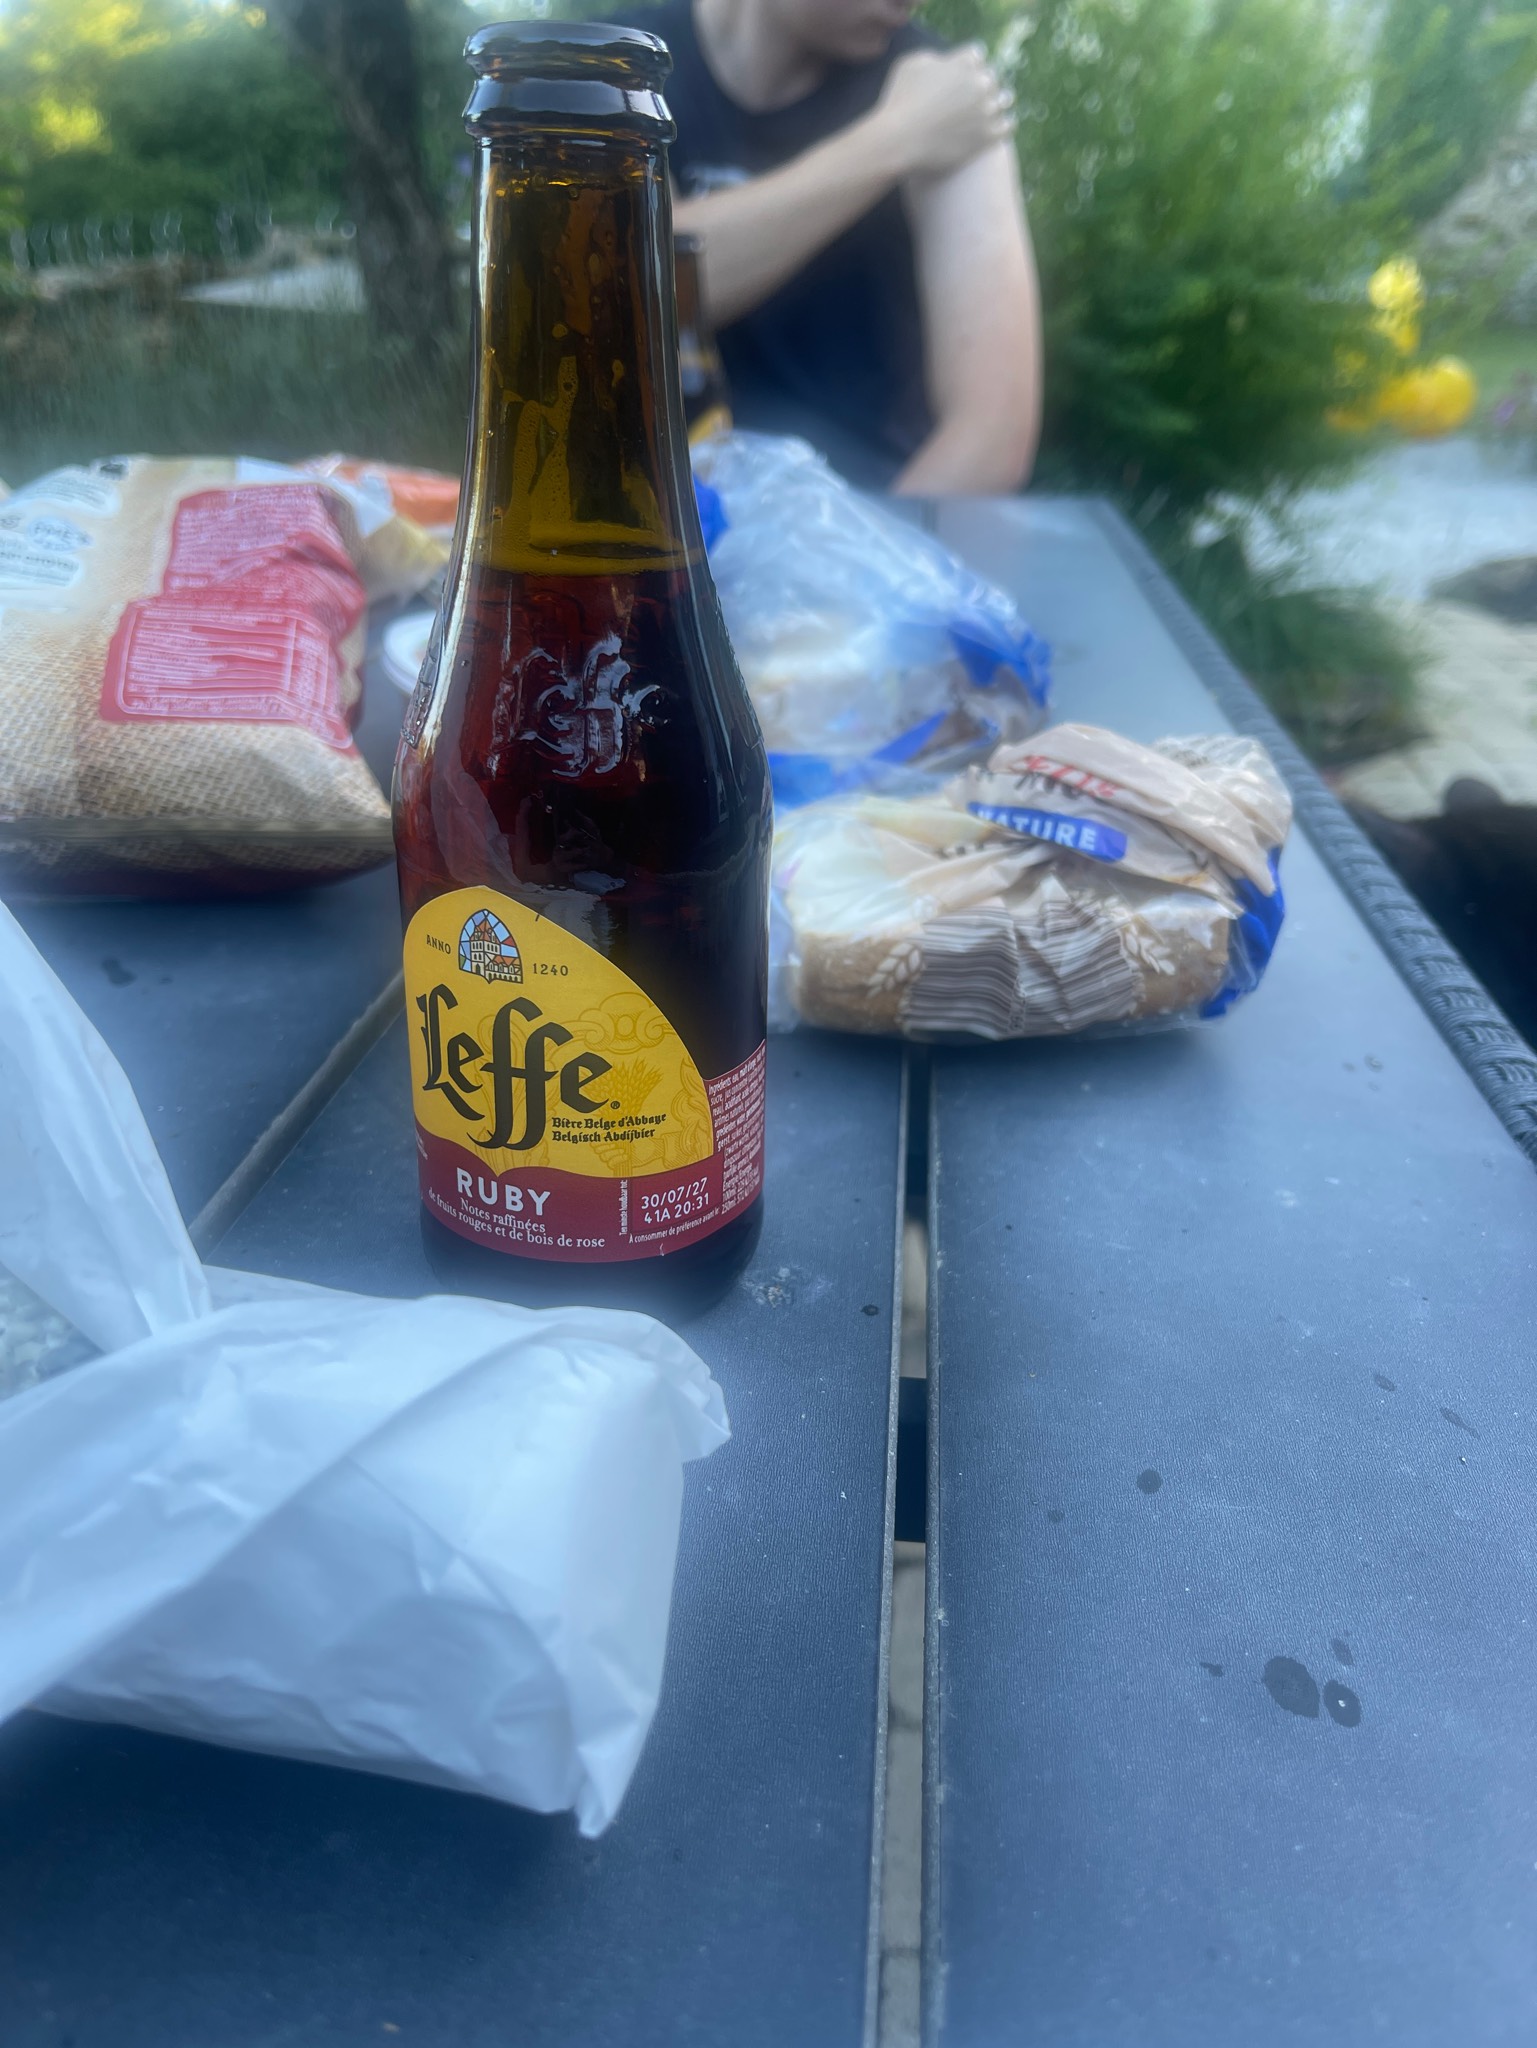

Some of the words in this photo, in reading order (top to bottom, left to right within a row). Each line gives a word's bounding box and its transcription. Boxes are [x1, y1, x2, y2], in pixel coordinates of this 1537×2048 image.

[426, 934, 451, 955] ANNO
[532, 963, 569, 977] 1240
[415, 983, 613, 1151] Leffe
[551, 1117, 583, 1129] Bière
[584, 1118, 617, 1131] Belge
[618, 1113, 667, 1128] d'Abbaye
[551, 1131, 601, 1144] Belgisch
[603, 1128, 656, 1144] Abdijbier
[456, 1167, 551, 1216] RUBY
[641, 1177, 708, 1210] 30/07/27
[674, 1192, 709, 1219] 20:31
[428, 1186, 437, 1201] de
[436, 1194, 458, 1217] fruits
[458, 1211, 493, 1233] rouges
[494, 1226, 507, 1237] et
[509, 1227, 524, 1241] de
[526, 1230, 554, 1246] bois
[557, 1234, 573, 1247] de
[576, 1237, 606, 1248] rose
[460, 1197, 490, 1221] Notes
[493, 1213, 546, 1233] raffinées
[634, 1230, 668, 1243] consommer
[668, 1226, 676, 1236] de
[676, 1217, 702, 1235] préférence
[702, 1210, 715, 1223] avant
